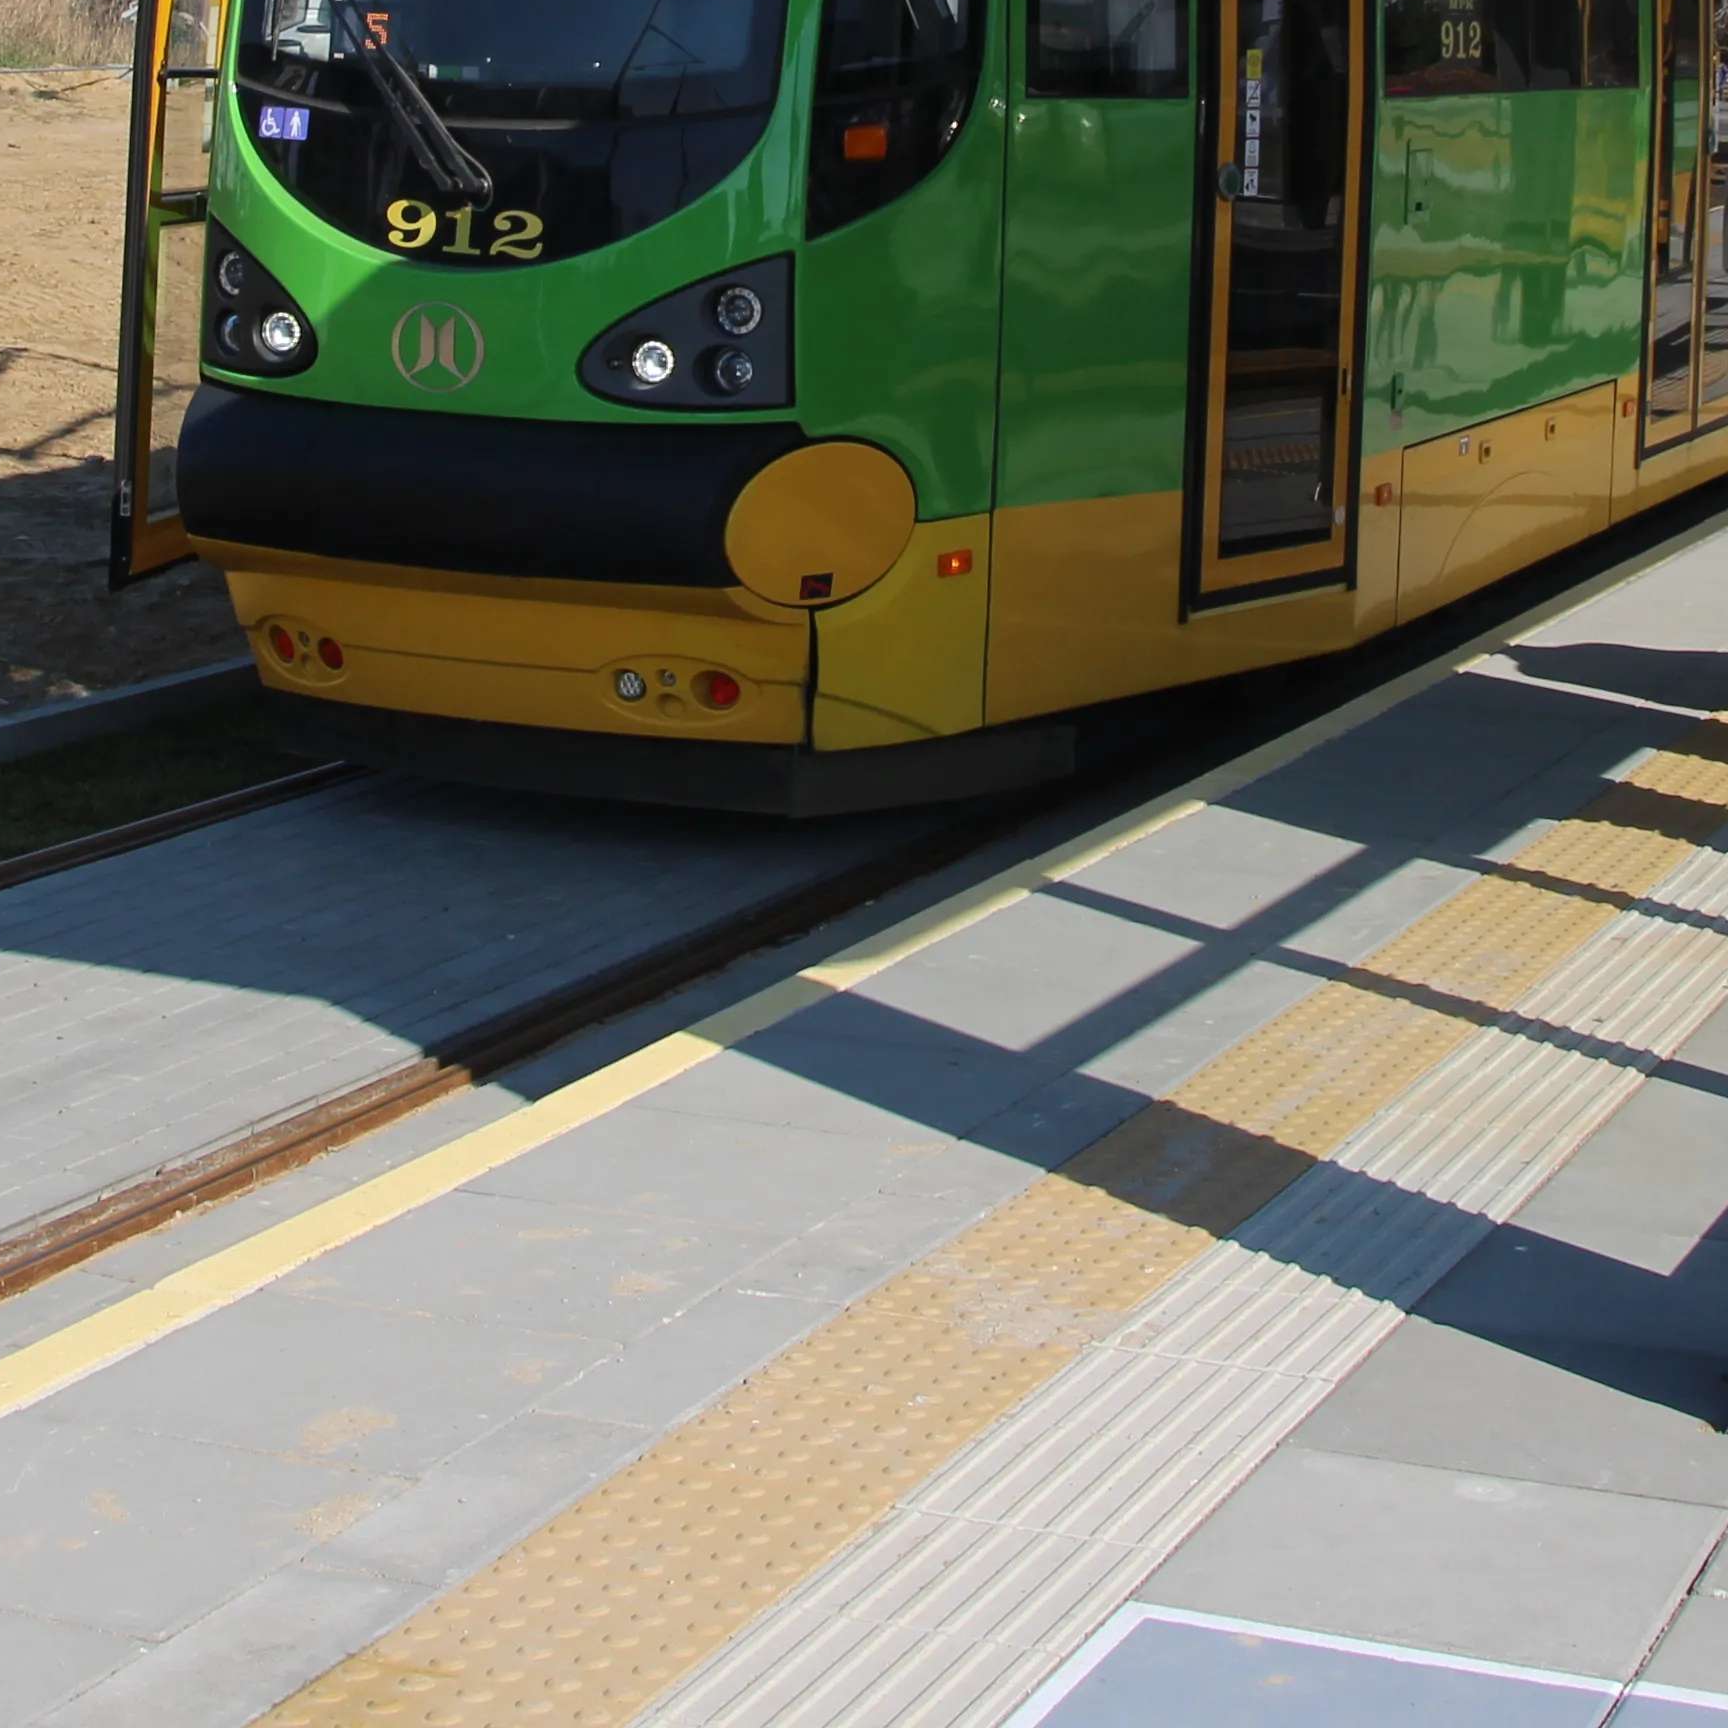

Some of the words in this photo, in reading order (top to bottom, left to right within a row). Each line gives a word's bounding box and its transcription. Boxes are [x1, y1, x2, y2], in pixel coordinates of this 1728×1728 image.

[364, 12, 389, 49] 5
[1441, 20, 1482, 59] 912
[386, 199, 544, 259] 912
